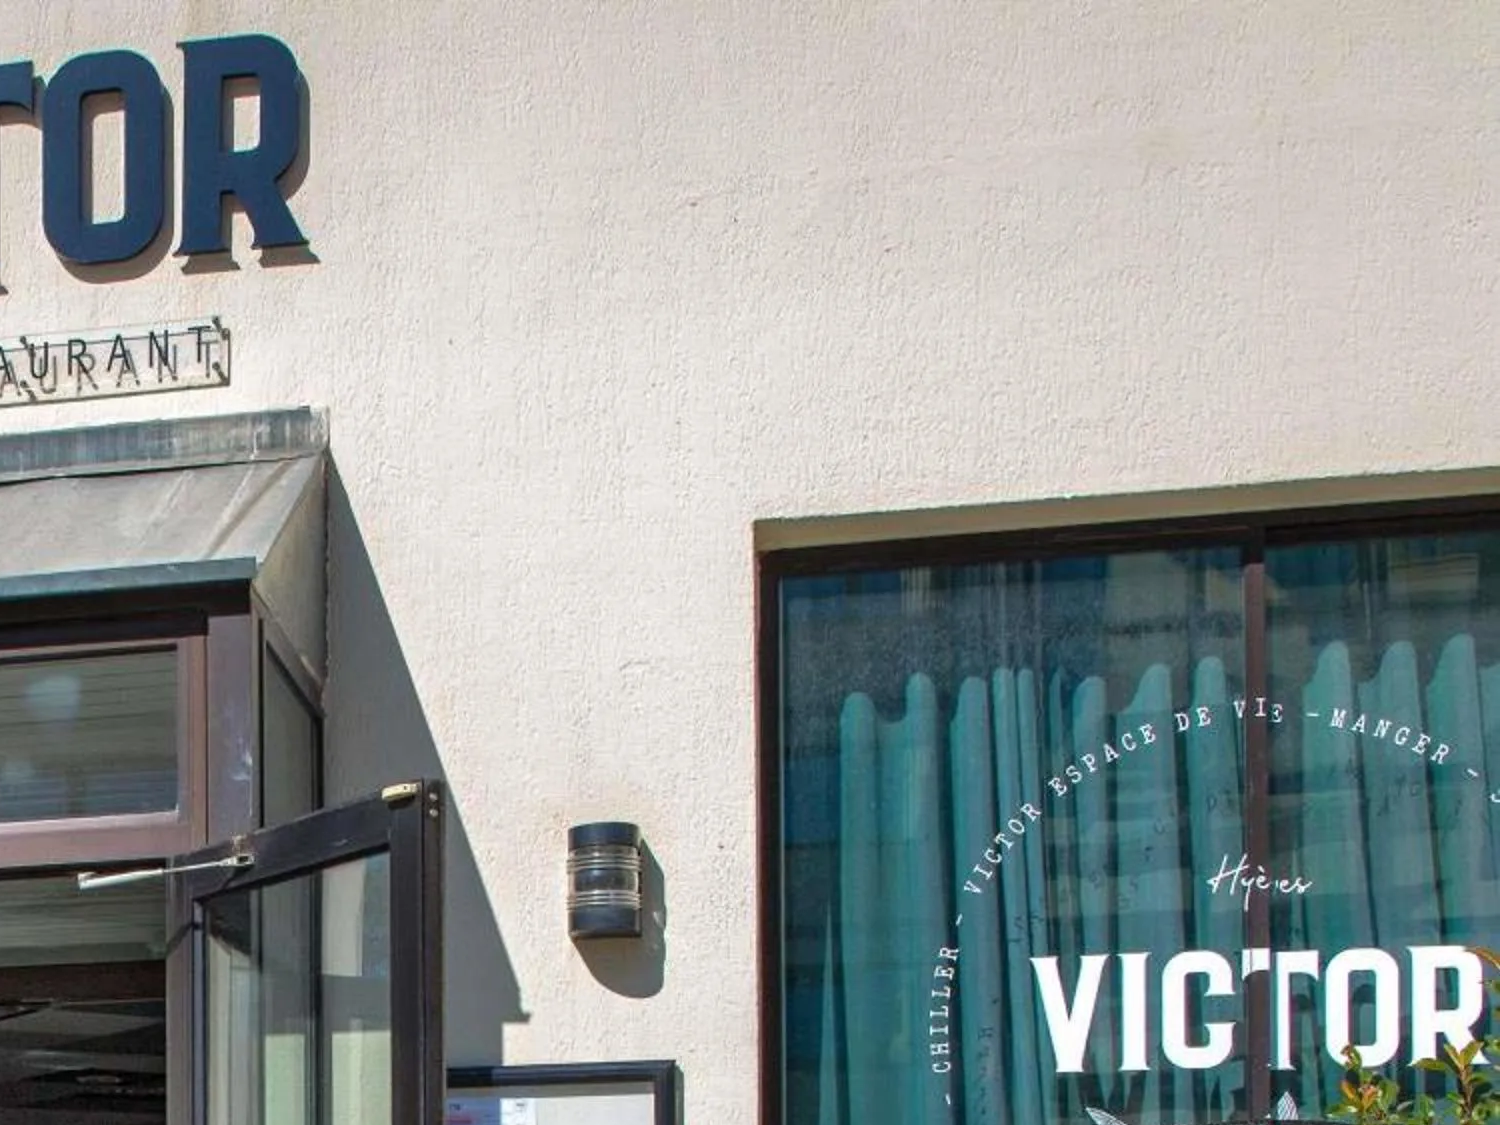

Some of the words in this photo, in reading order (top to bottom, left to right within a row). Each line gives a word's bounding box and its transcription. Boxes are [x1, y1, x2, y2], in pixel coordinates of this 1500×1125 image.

[964, 801, 1042, 894] VICTOR
[1048, 723, 1157, 797] ESPACE
[1174, 705, 1212, 732] DE
[1233, 697, 1284, 723] VIE
[930, 945, 959, 1074] CHILLER
[1029, 945, 1491, 1073] VICTOR
